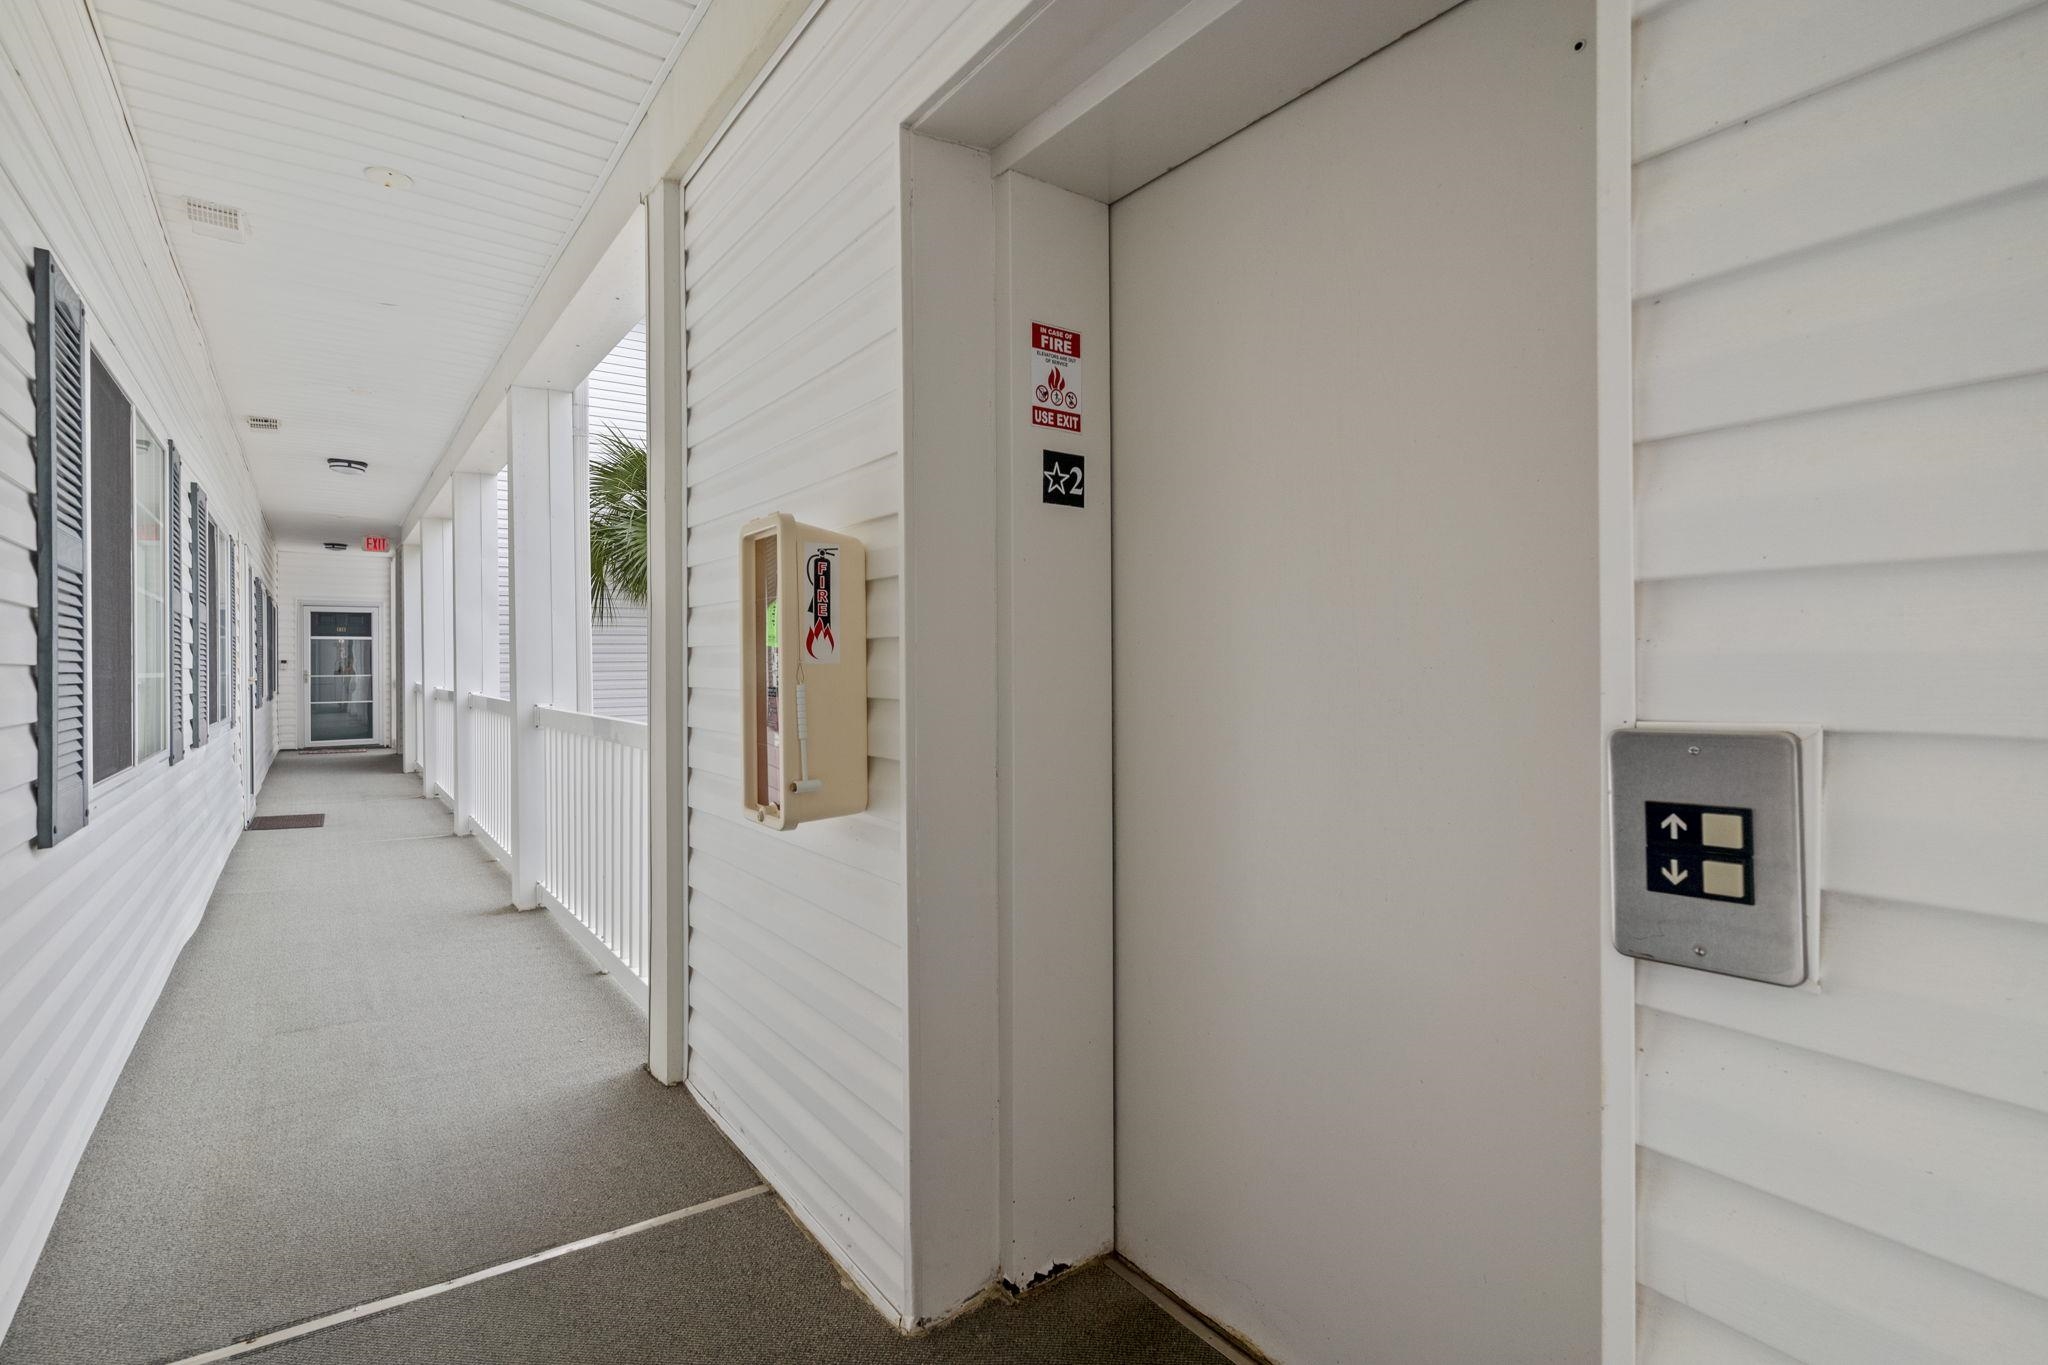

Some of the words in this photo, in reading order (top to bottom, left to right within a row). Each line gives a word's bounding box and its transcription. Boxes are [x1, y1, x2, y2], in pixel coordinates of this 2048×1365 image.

[1048, 329, 1064, 338] CASE
[1041, 335, 1072, 354] FIRE
[1036, 350, 1059, 359] ELEVATORS
[1034, 409, 1054, 425] USE
[1057, 414, 1078, 430] EXIT
[1069, 466, 1083, 495] 2
[366, 537, 386, 551] EXIT
[817, 562, 828, 616] FIRE
